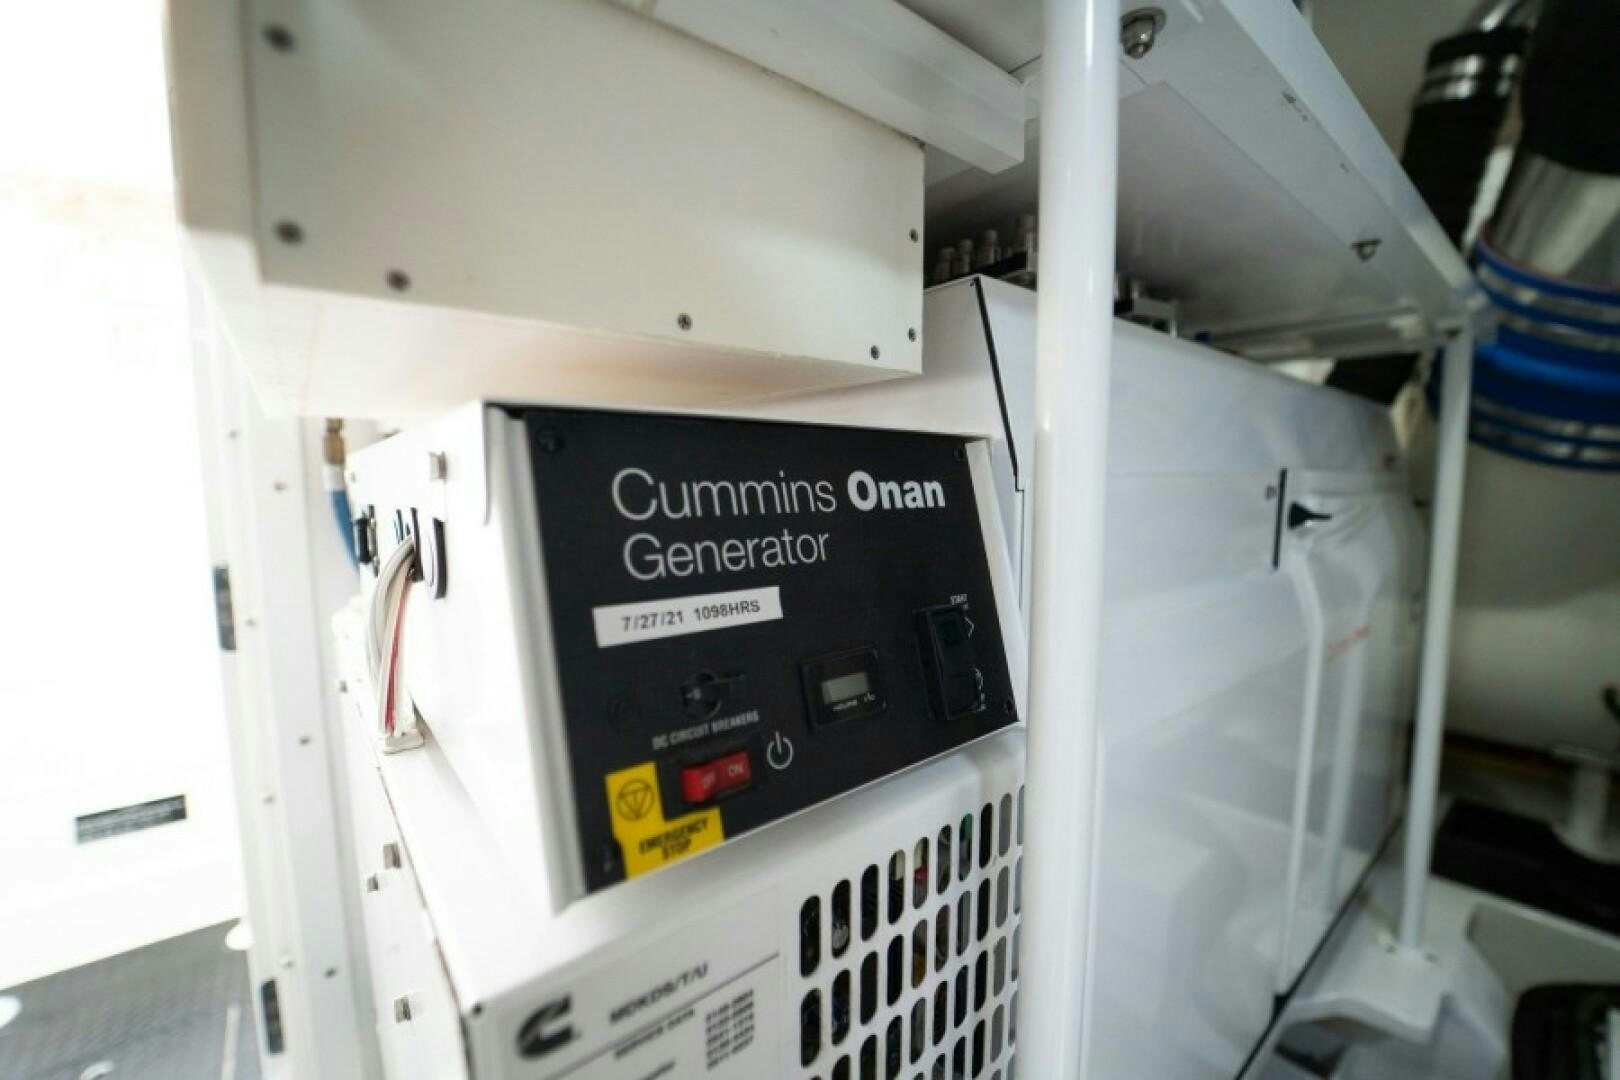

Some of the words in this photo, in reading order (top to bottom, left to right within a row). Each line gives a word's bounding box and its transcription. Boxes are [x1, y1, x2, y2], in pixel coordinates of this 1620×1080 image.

[611, 467, 837, 521] Cummins
[848, 471, 946, 512] Onan
[623, 529, 830, 580] Generator
[621, 610, 684, 633] 7/27/21
[694, 599, 761, 621] 1098HRS
[669, 722, 709, 746] CIRCUIT
[711, 709, 760, 734] BREAKERS
[638, 817, 709, 855] EMERGENCY
